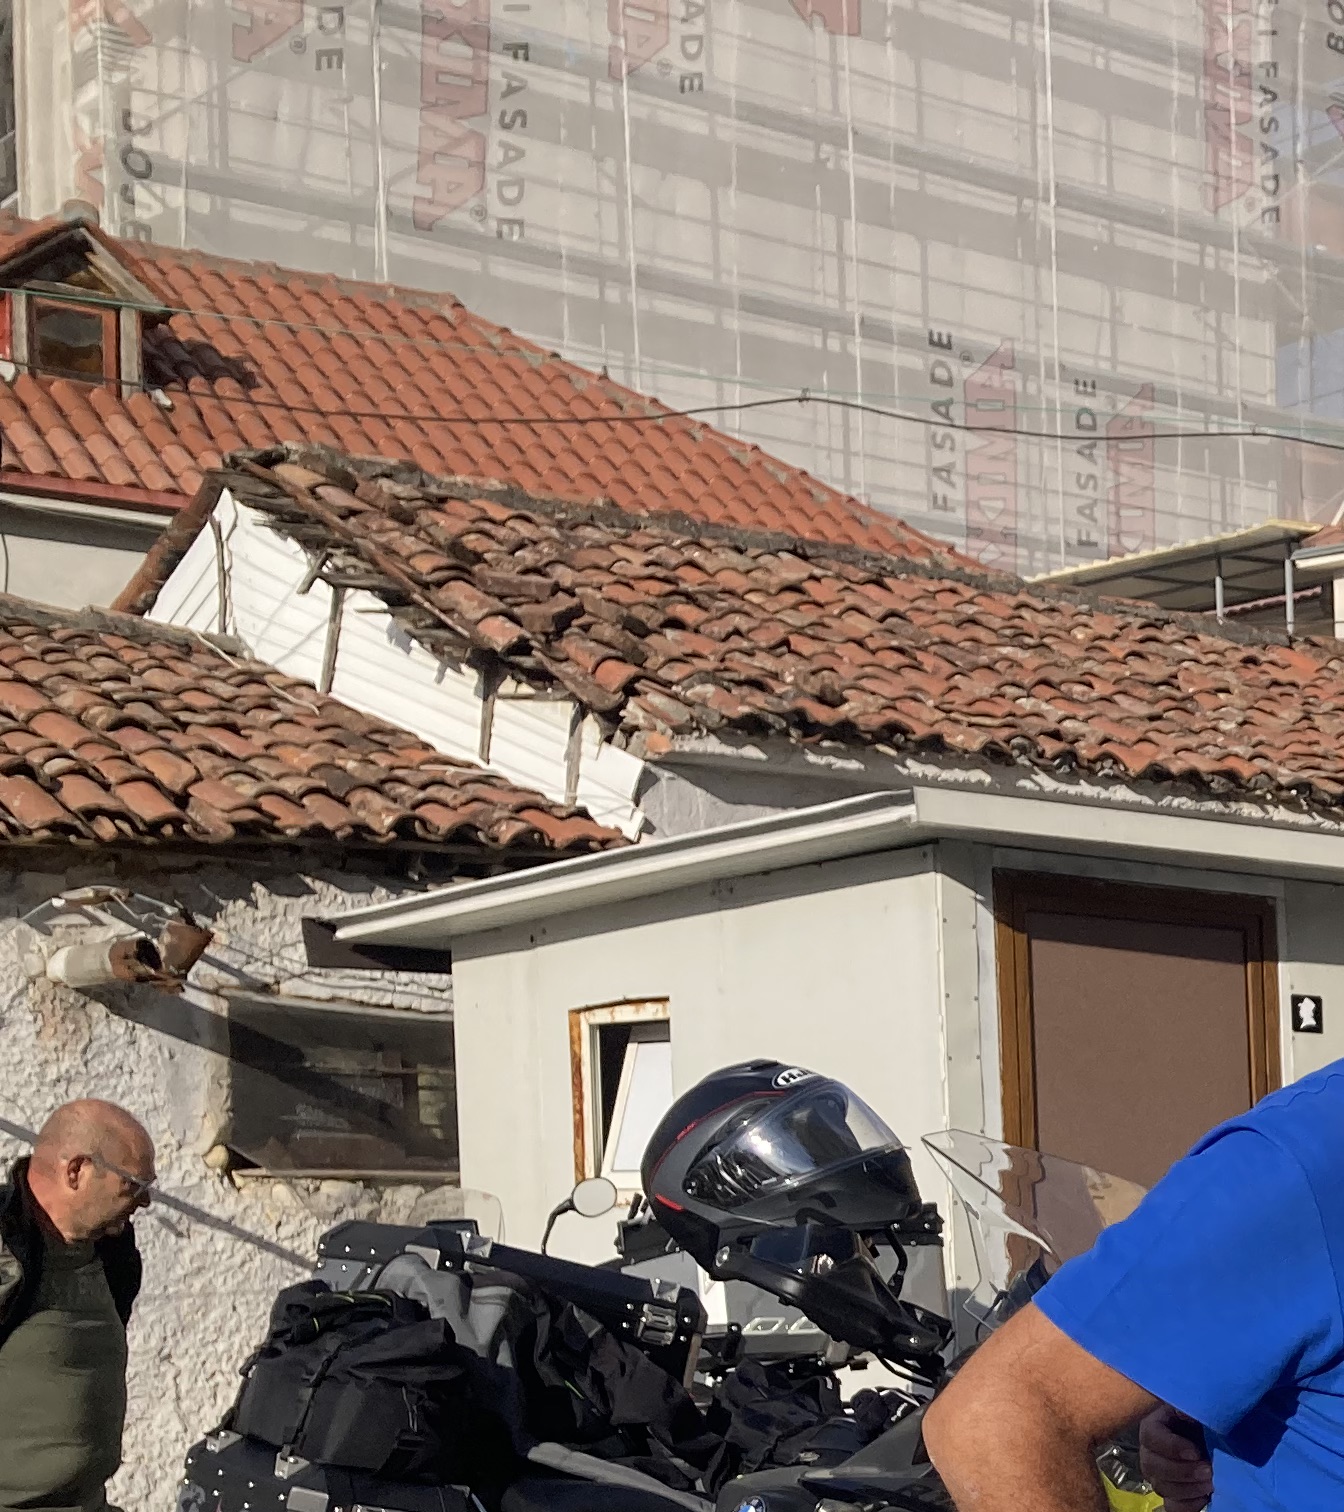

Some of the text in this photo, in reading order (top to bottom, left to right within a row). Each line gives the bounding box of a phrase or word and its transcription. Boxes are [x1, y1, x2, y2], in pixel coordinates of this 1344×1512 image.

[497, 42, 530, 240] FASADE
[1259, 61, 1281, 224] FASADE
[928, 329, 956, 512] FASADE
[1074, 378, 1098, 548] FASADE
